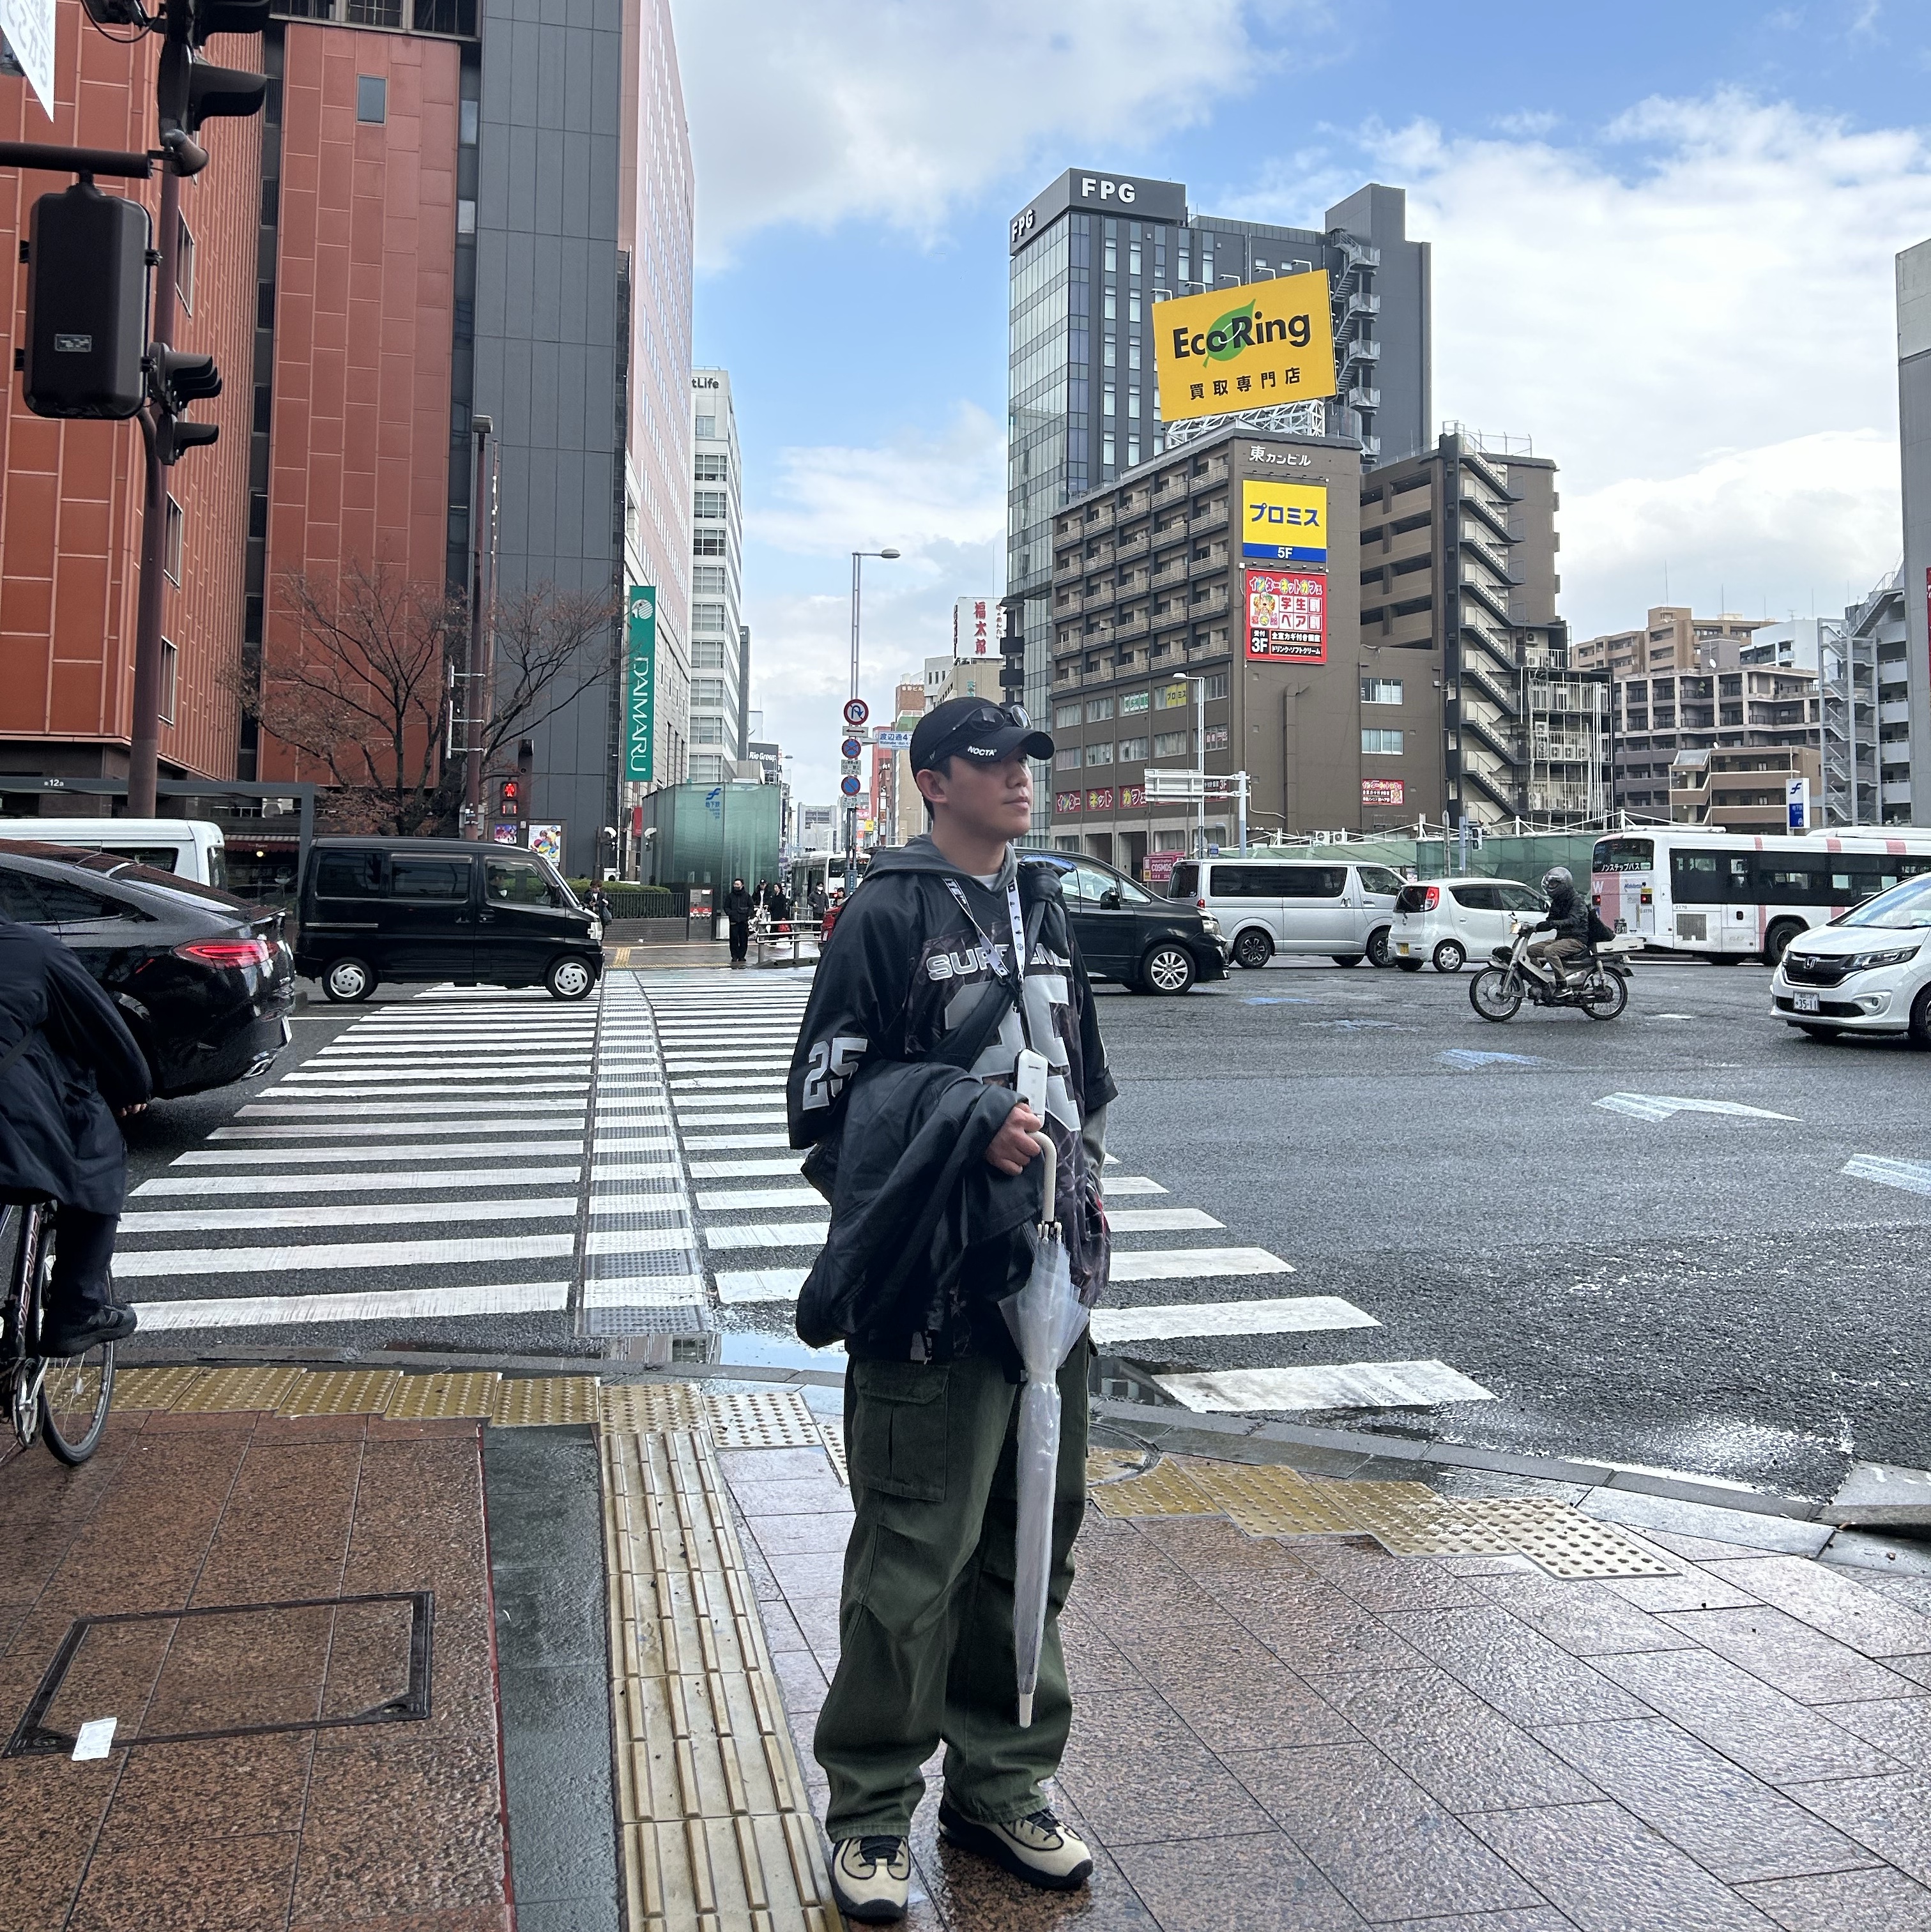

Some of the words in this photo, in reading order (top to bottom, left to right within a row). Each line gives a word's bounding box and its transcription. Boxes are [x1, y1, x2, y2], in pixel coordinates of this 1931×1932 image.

[1081, 178, 1135, 203] FPG
[1012, 209, 1034, 242] FPG
[1190, 367, 1301, 400] 買取専門店
[1249, 445, 1311, 467] 東カンビル
[1249, 503, 1320, 527] プロミス
[1278, 547, 1293, 559] 5F
[1249, 576, 1323, 596] インターネットカフェ
[974, 601, 986, 656] 福太郎
[1252, 637, 1268, 653] 3F
[630, 657, 649, 772] DAIMARU
[1601, 862, 1640, 872] ノンステップバス
[803, 1037, 867, 1111] 25
